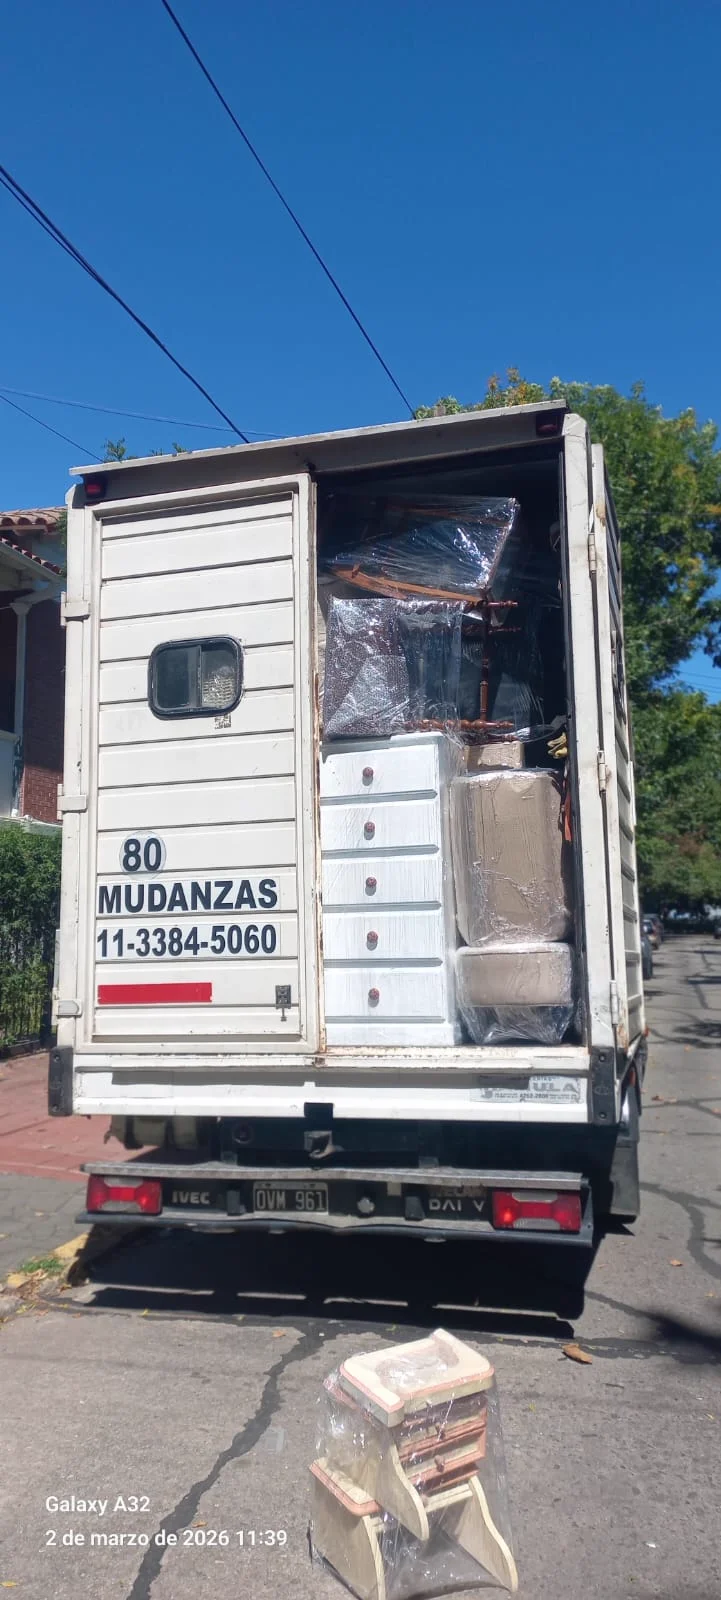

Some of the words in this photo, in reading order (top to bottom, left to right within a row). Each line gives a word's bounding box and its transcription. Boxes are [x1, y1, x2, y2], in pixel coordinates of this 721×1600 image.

[122, 838, 162, 872] 80
[98, 878, 278, 914] MUDANZAS
[97, 924, 277, 957] 11-3384-5060
[256, 1190, 286, 1210] OVM
[295, 1191, 325, 1211] 961
